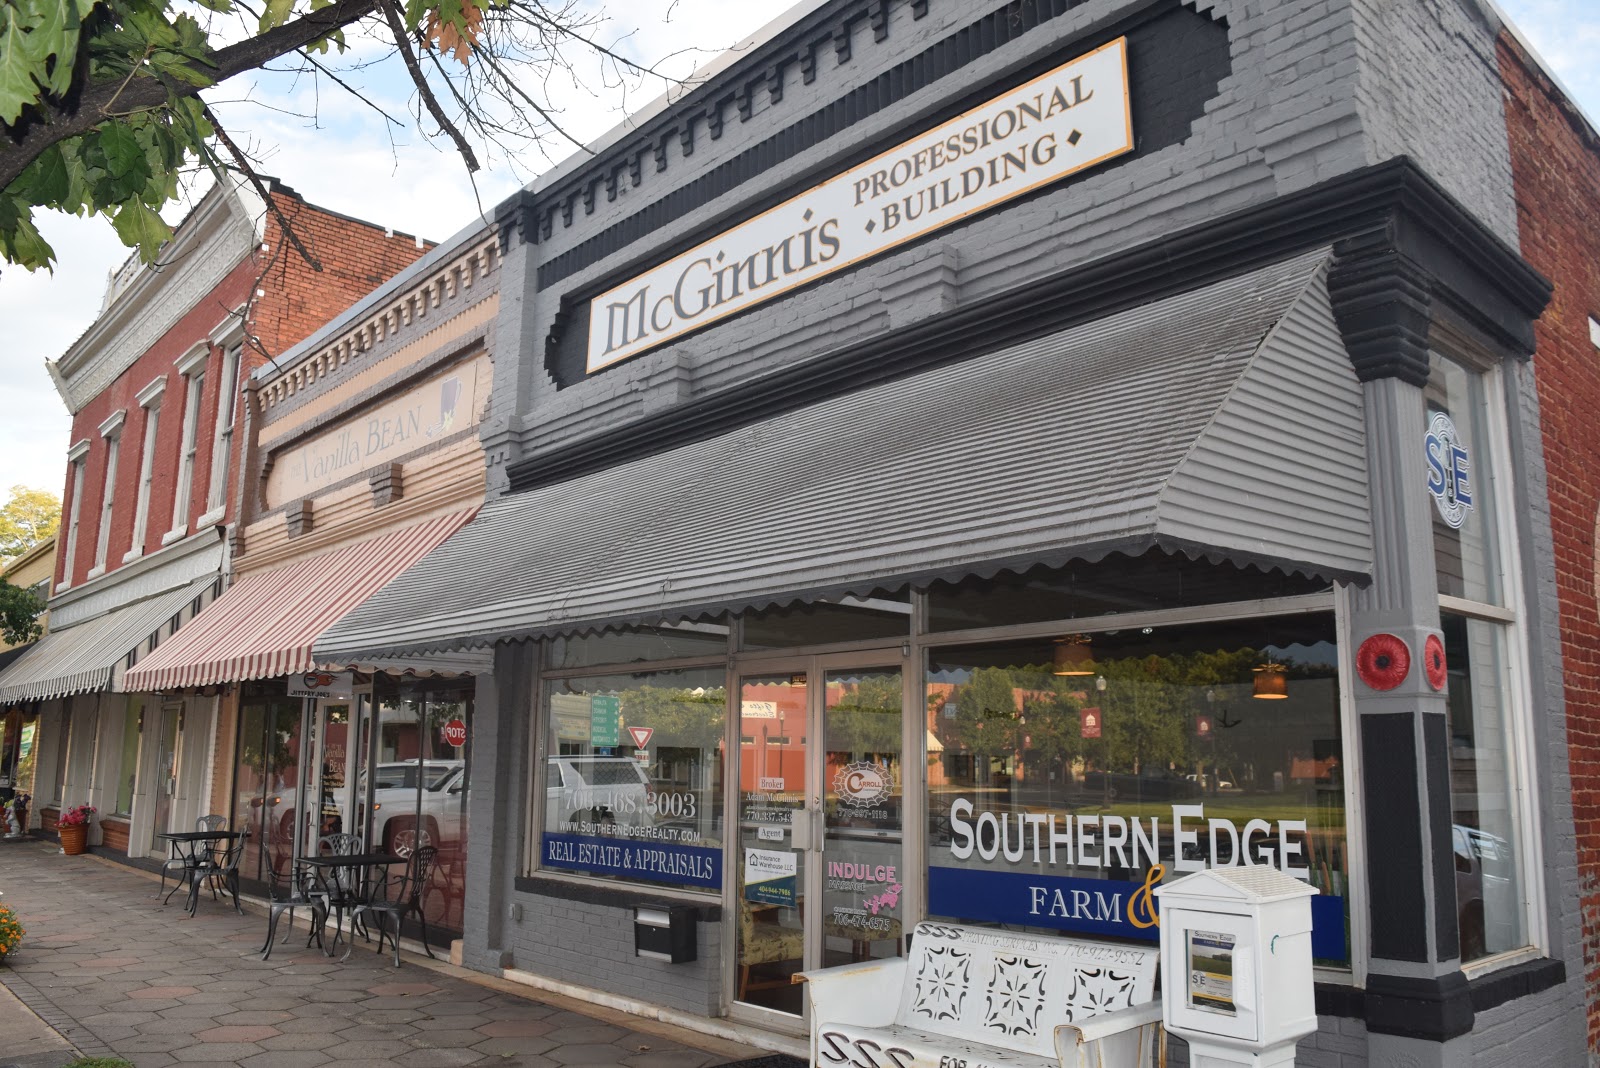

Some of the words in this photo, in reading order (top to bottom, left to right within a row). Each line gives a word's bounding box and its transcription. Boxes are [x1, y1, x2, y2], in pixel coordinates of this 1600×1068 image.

[853, 74, 1095, 207] PROFESSIONAL
[881, 134, 1059, 234] BUILDING
[602, 208, 841, 358] McGinnis
[302, 430, 360, 483] Vanilla
[365, 406, 423, 457] BEAN
[761, 779, 783, 788] Broker
[847, 772, 881, 793] CARROLL
[565, 788, 696, 818] 706.468.3003
[746, 792, 764, 801] Adam
[766, 793, 799, 803] McGinnis
[746, 811, 792, 823] 770.337.543
[761, 829, 781, 839] Agent
[950, 798, 1161, 870] SOUTHERN
[1171, 803, 1310, 880] EDGE
[548, 840, 576, 862] REAL
[578, 843, 621, 868] ESTATE
[623, 848, 632, 869] &
[634, 848, 713, 880] APPRAISALS
[758, 861, 784, 870] Warehouse
[828, 861, 896, 883] INDULGE
[828, 880, 866, 892] MASSAGE
[1029, 885, 1123, 924] FARM
